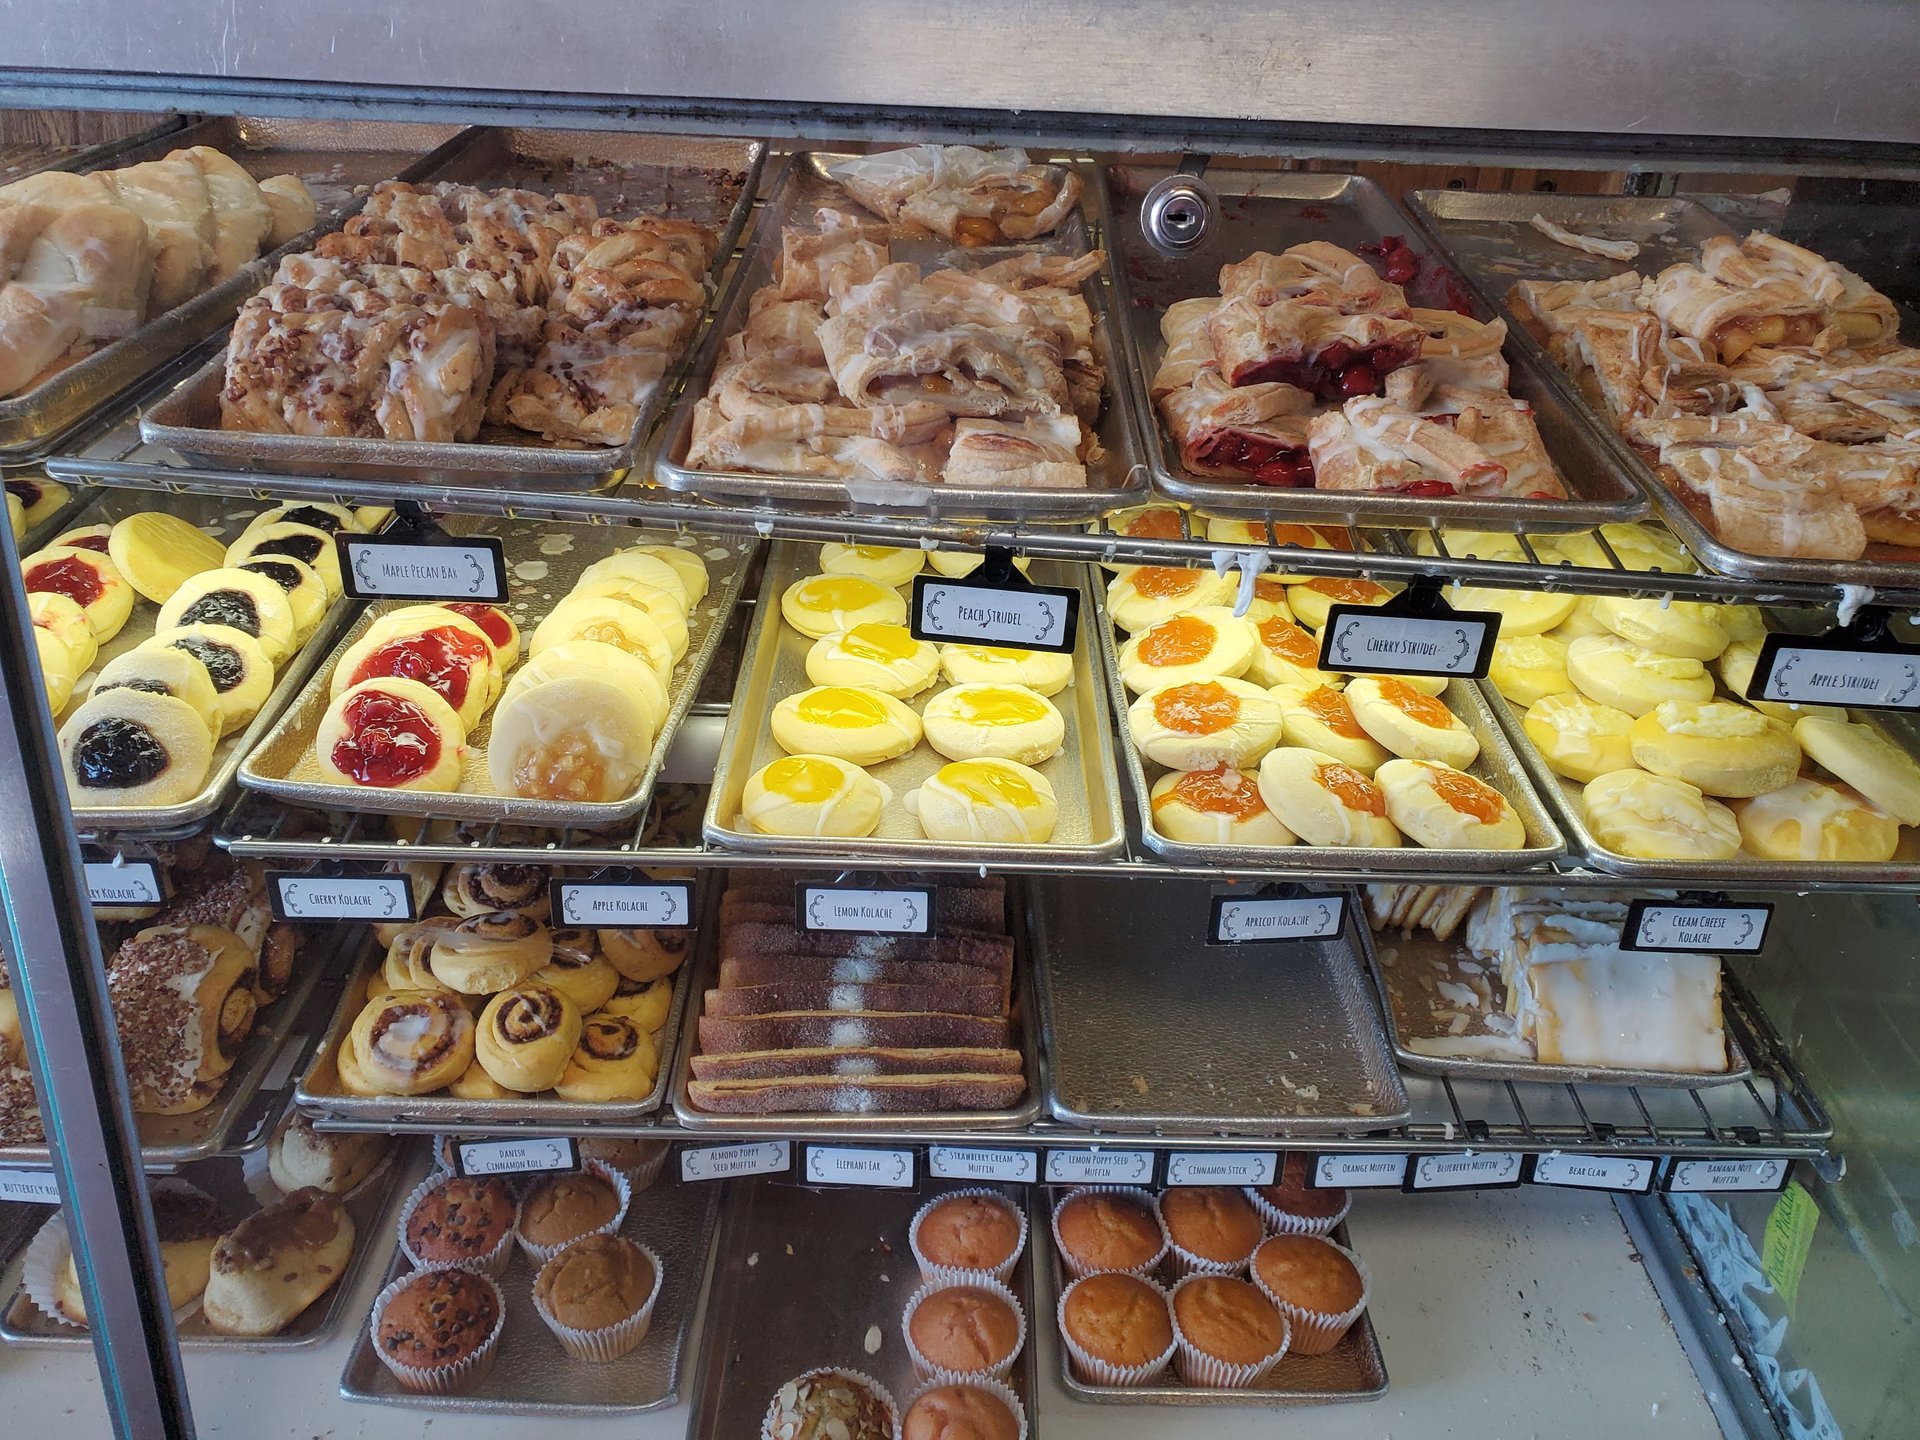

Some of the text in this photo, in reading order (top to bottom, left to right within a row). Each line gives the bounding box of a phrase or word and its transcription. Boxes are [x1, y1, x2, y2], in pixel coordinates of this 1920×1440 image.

[382, 563, 409, 578] MAPLE
[410, 564, 440, 579] PECAN
[958, 605, 1021, 626] PEACH STRUDEL
[1366, 637, 1400, 653] CHERRY
[1809, 672, 1837, 688] APPLE
[89, 888, 135, 899] RY KOLACHE
[309, 893, 371, 906] CHERRY KOLACHE
[592, 900, 648, 912] APPLE KOLACHE
[834, 905, 892, 918] LEMON KOLACHE
[1245, 916, 1277, 927] APRICOT
[1672, 915, 1725, 928] CREAM CHEESE
[1678, 931, 1711, 943] KOLACHE
[499, 1149, 525, 1159] DANISH
[710, 1148, 759, 1161] ALMOND POPPY
[950, 1151, 1013, 1163] STRAWBERRY CREAM
[1068, 1155, 1128, 1165] LEMON POPPY SEED
[486, 1159, 543, 1170] CINNAMON ROLL
[713, 1160, 756, 1172] SEED MUFFIN
[836, 1159, 880, 1171] ELEPHANT EAR
[968, 1163, 995, 1174] MUFFIN
[1188, 1165, 1247, 1175] CINNAMON STICK
[1342, 1163, 1395, 1172] ORANGE MUFFIN
[1437, 1160, 1497, 1173] BLUEBERRY MUFFIN
[1707, 1164, 1752, 1173] BANANA NUT
[1084, 1167, 1110, 1177] MUFFIN
[1569, 1166, 1606, 1177] BEAR CLAW
[1712, 1175, 1739, 1184] MUFFIN
[4, 1183, 44, 1194] BUTTERFLY
